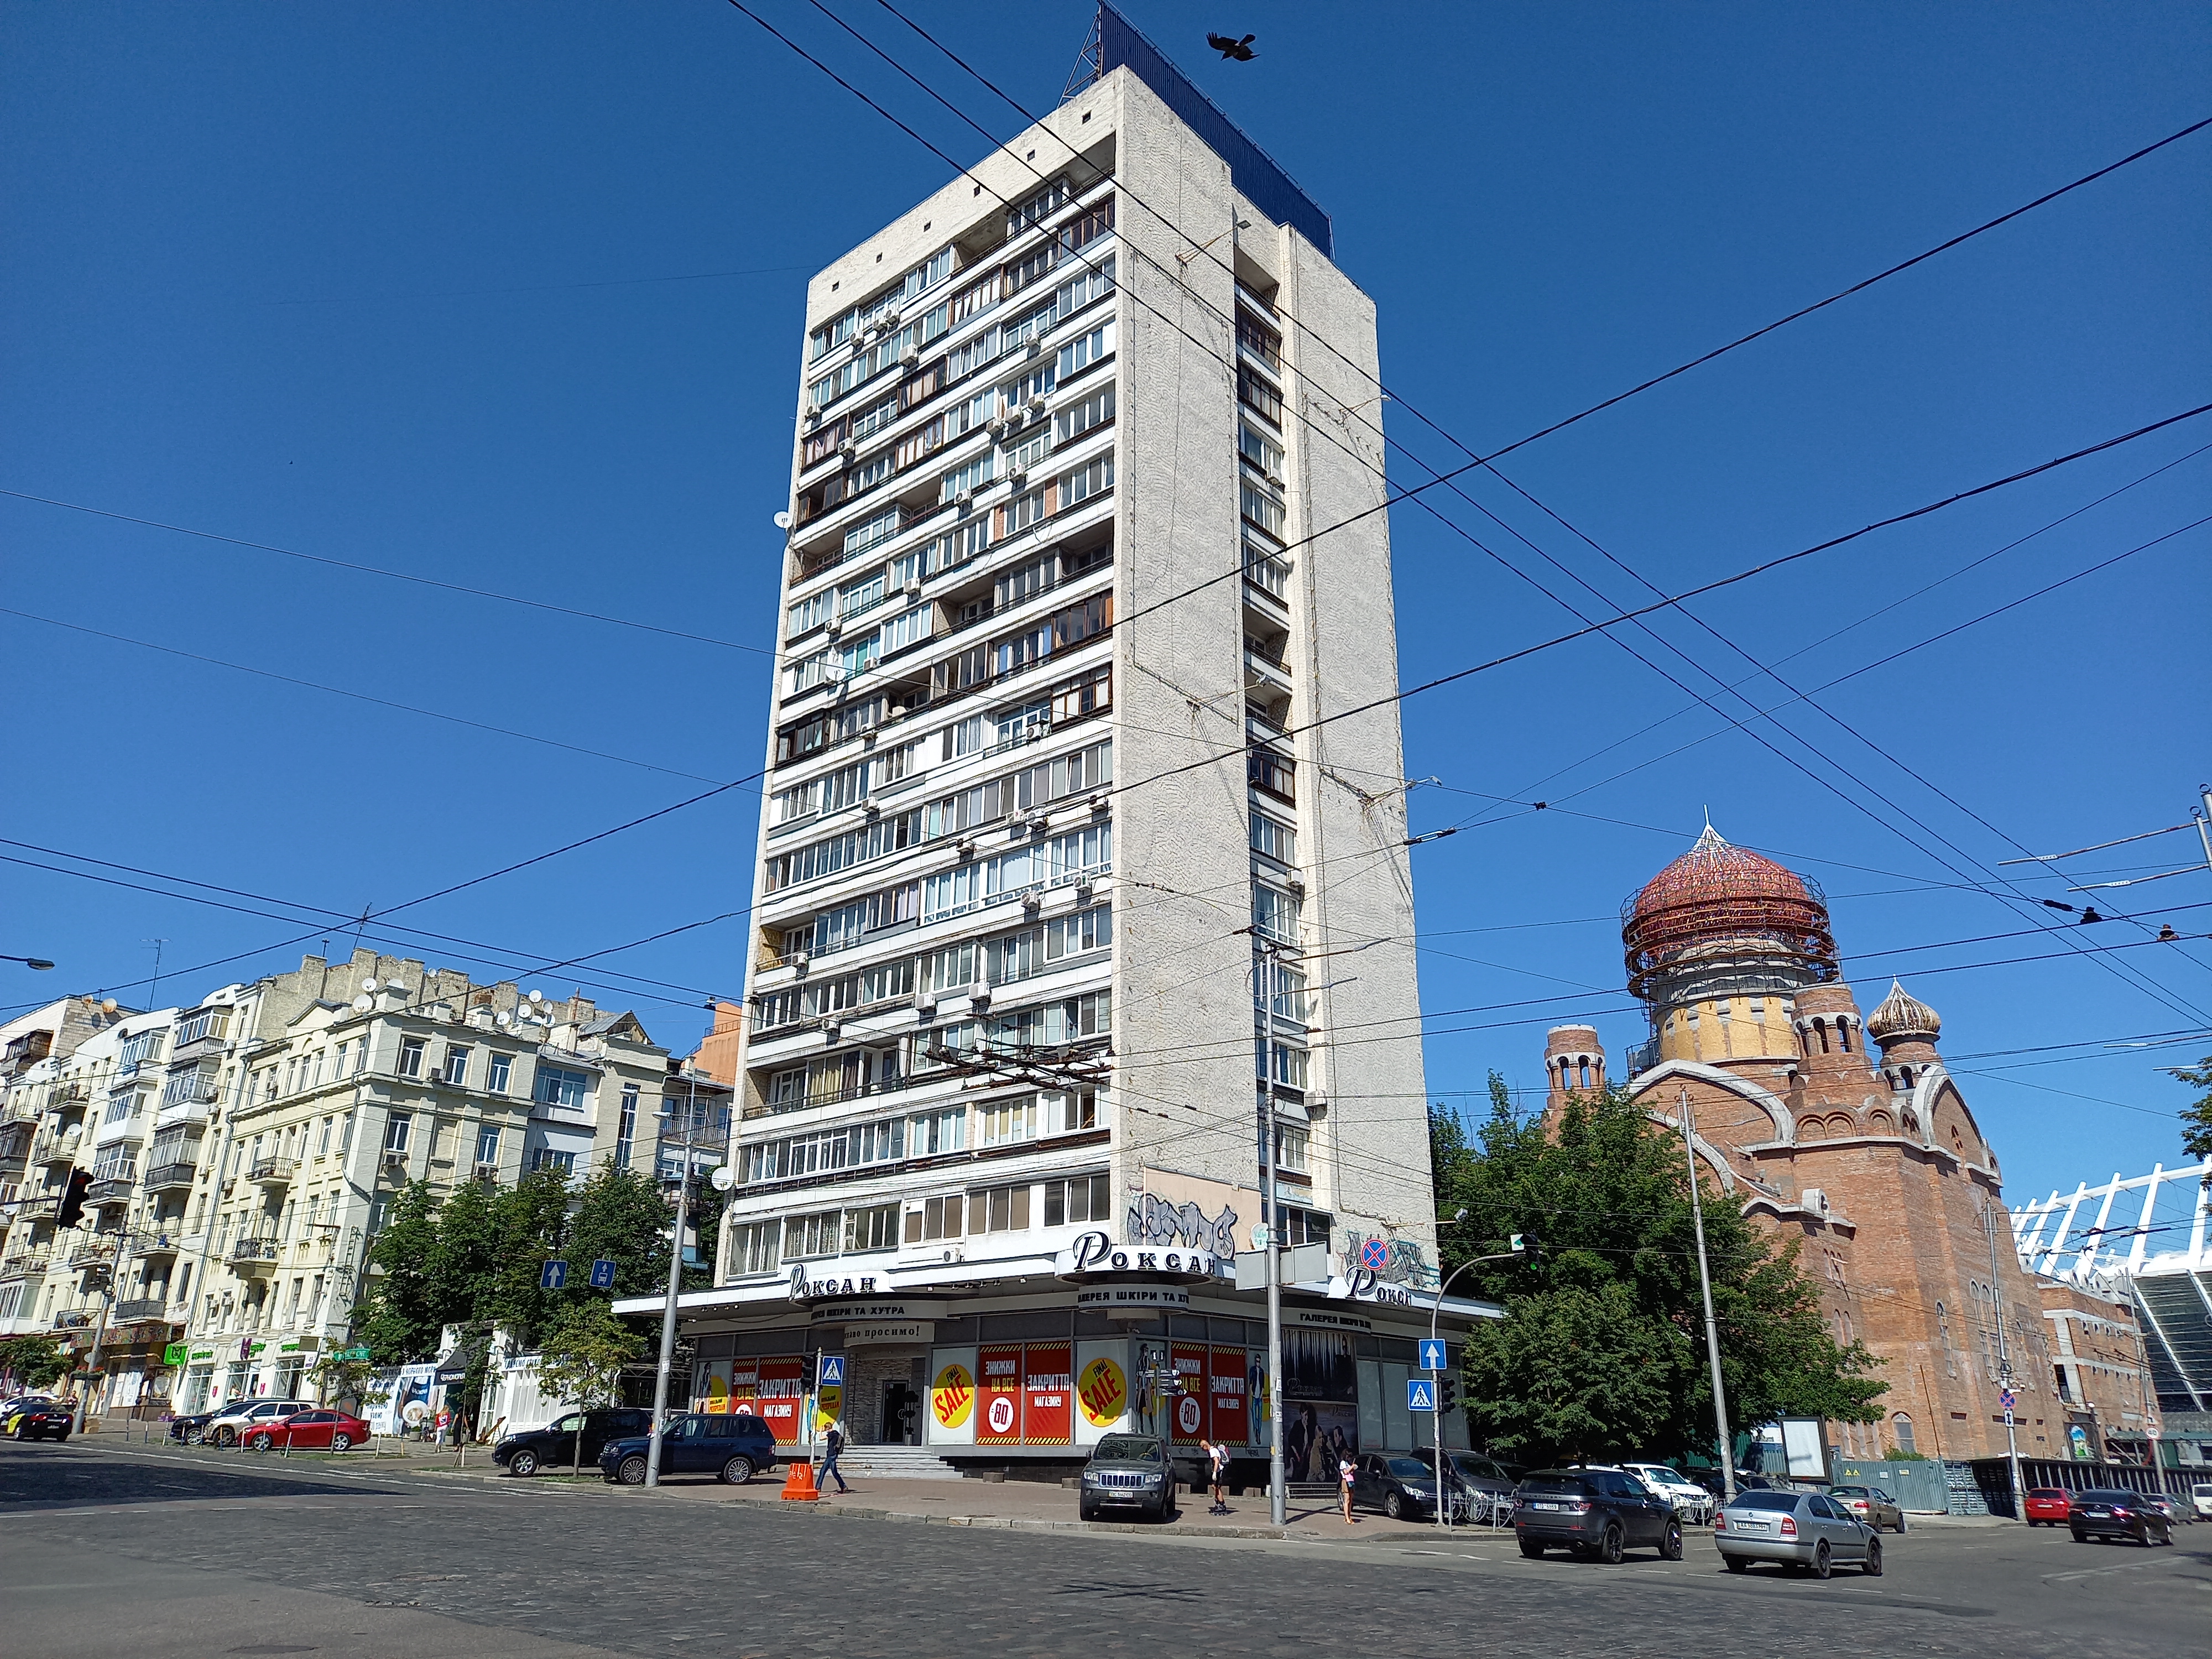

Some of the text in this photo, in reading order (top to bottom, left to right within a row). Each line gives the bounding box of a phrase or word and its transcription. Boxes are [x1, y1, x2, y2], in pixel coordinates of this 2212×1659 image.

[1116, 1291, 1157, 1300] ШКІРИ
[1162, 1292, 1176, 1302] ТА
[854, 1307, 866, 1316] ТА
[870, 1306, 905, 1315] ХУТРА
[1300, 1313, 1338, 1324] ГАЛЕРЕЯ
[864, 1325, 920, 1339] просимо!
[946, 1365, 959, 1383] FINAL
[985, 1359, 1016, 1375] ЗНИЖКИ
[1092, 1359, 1108, 1378] FINAL
[1174, 1358, 1201, 1375] ЗНИЖКИ
[733, 1371, 757, 1386] ЗНИЖКИ
[991, 1378, 1015, 1392] НА ВСЕ
[1027, 1374, 1070, 1391] ЗАКРИТТЯ
[1190, 1377, 1201, 1392] ВСЕ
[1211, 1375, 1244, 1395] ЗАКРИТТЯ
[737, 1386, 755, 1401] НА ВСЕ
[758, 1378, 801, 1400] ЗАКРИТТЯ
[1081, 1368, 1121, 1422] SALE
[934, 1374, 970, 1423] SALE
[1034, 1395, 1062, 1407] МАГАЗИНУ
[1217, 1397, 1239, 1410] МАГАЗИНУ
[763, 1404, 792, 1418] МАГАЗИНУ
